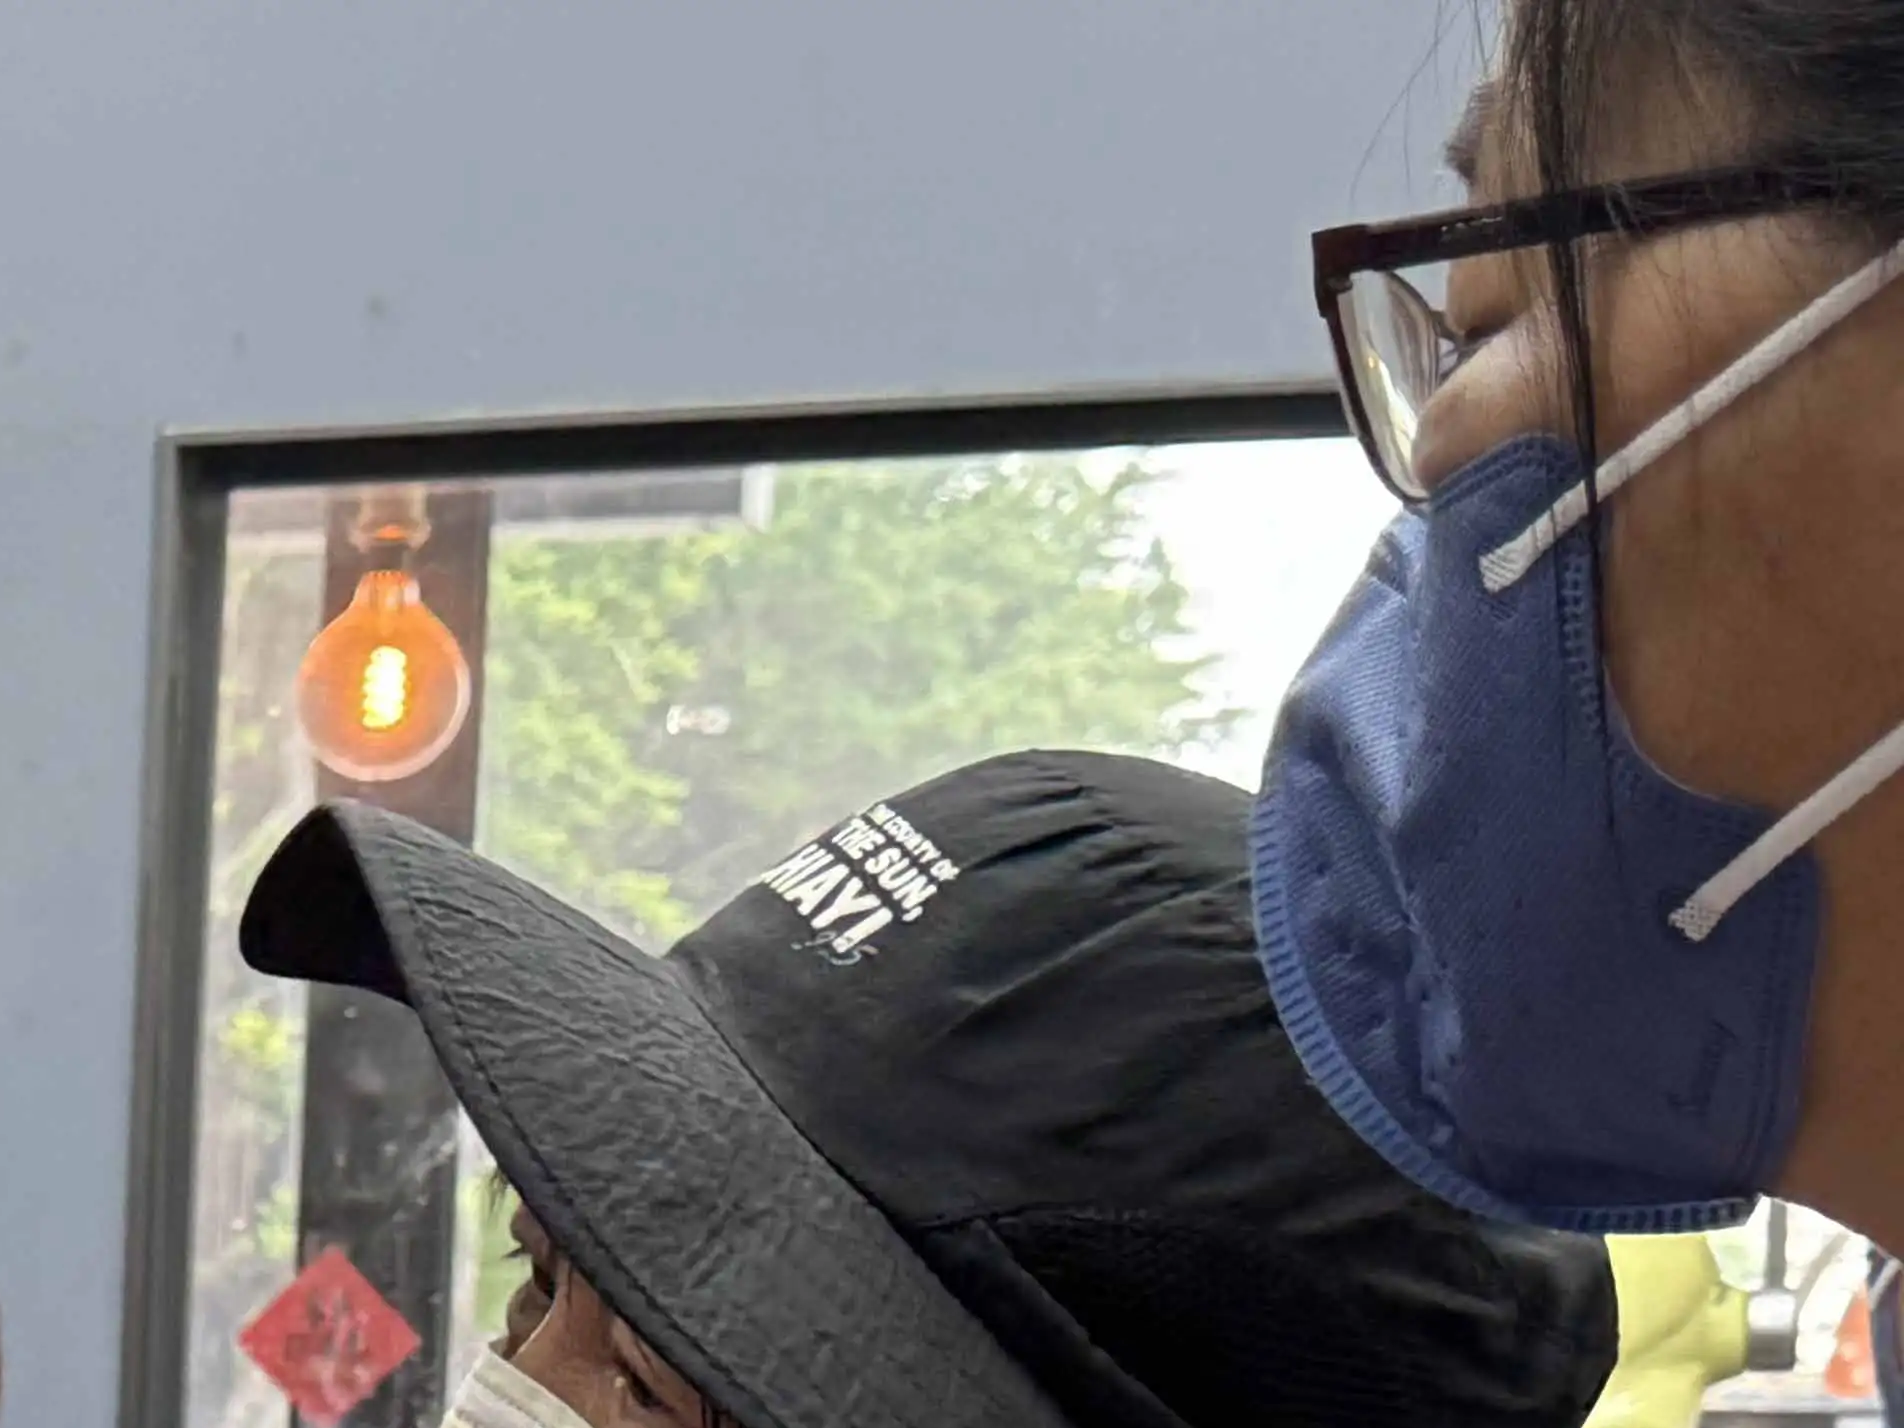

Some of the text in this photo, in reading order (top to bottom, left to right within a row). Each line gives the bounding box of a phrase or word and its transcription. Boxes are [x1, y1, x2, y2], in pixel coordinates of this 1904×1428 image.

[759, 842, 894, 954] HIAYI
[832, 817, 888, 860] THE
[864, 847, 937, 922] SUN,
